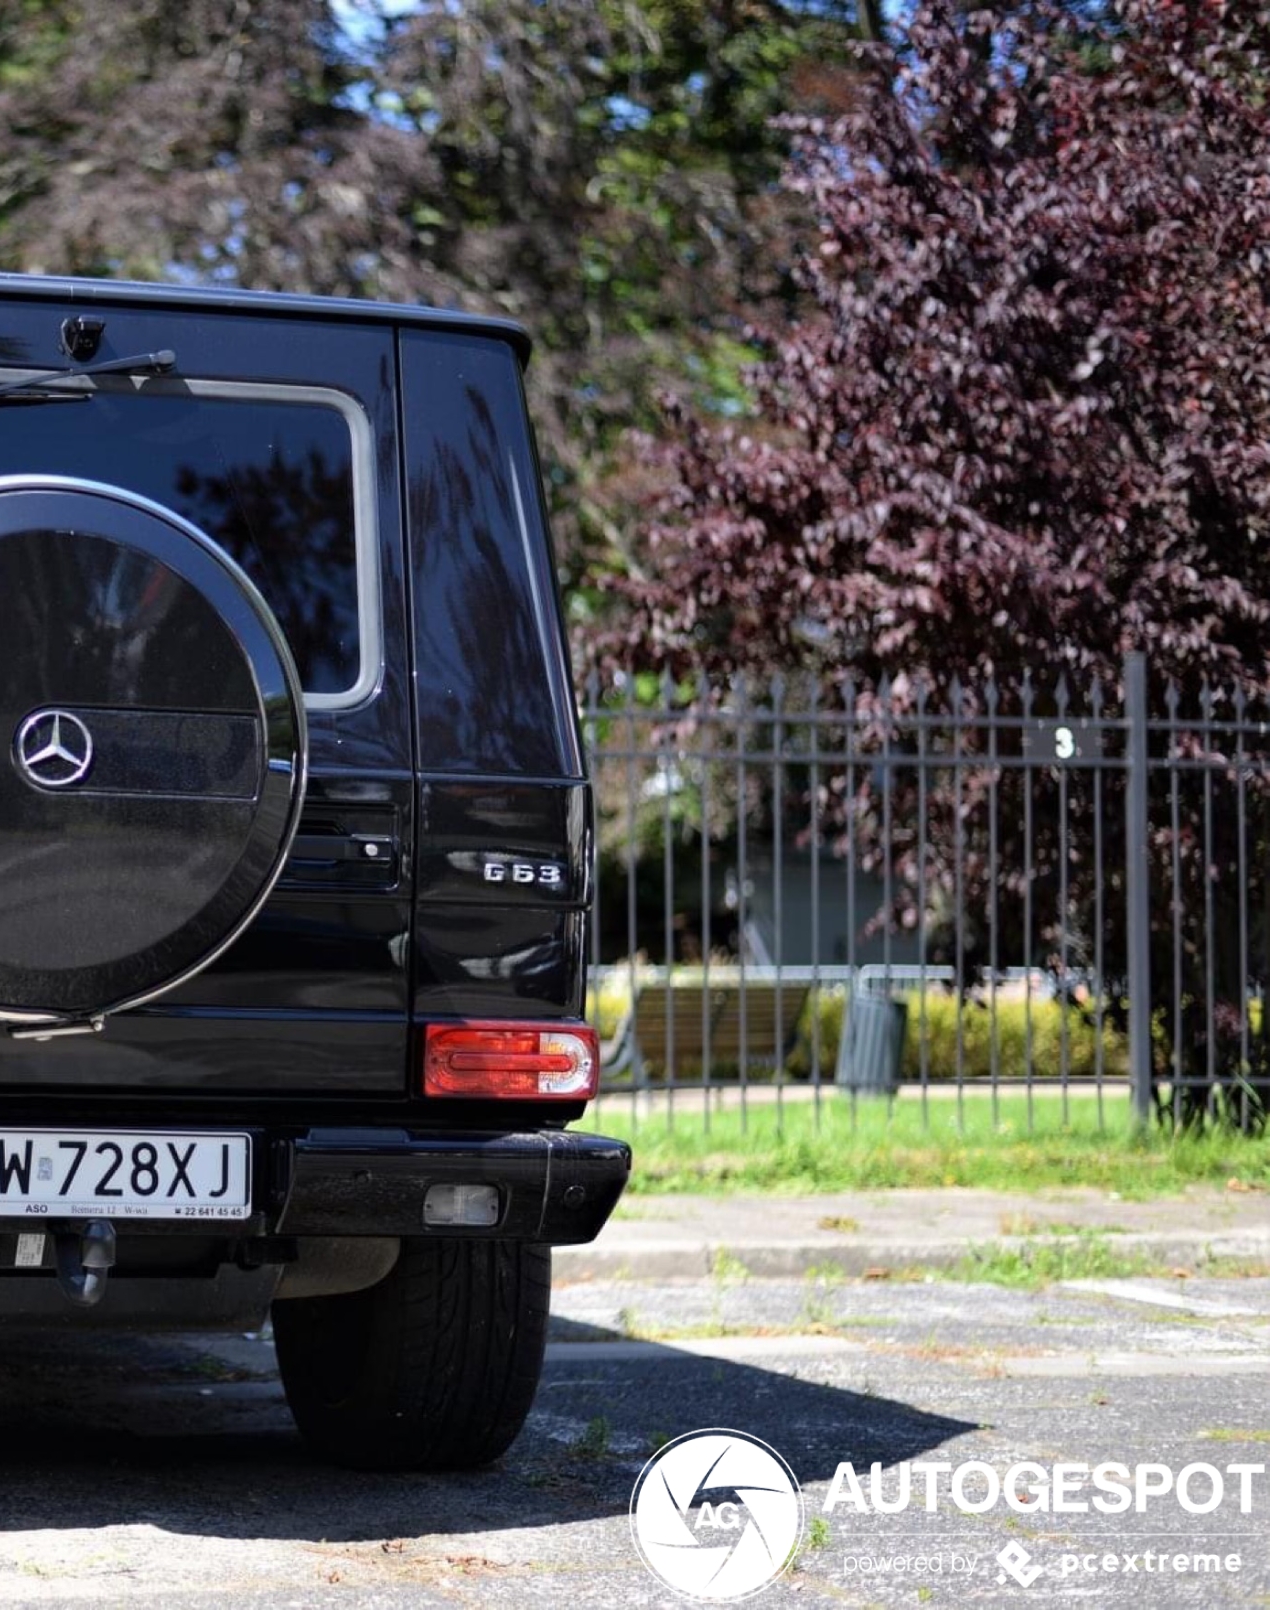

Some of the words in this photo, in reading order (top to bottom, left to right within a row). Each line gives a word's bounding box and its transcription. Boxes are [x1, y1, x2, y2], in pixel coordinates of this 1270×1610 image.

[1055, 726, 1075, 759] 3
[58, 1140, 230, 1198] 728XJ
[25, 1204, 48, 1214] ASO
[184, 1206, 196, 1216] 22
